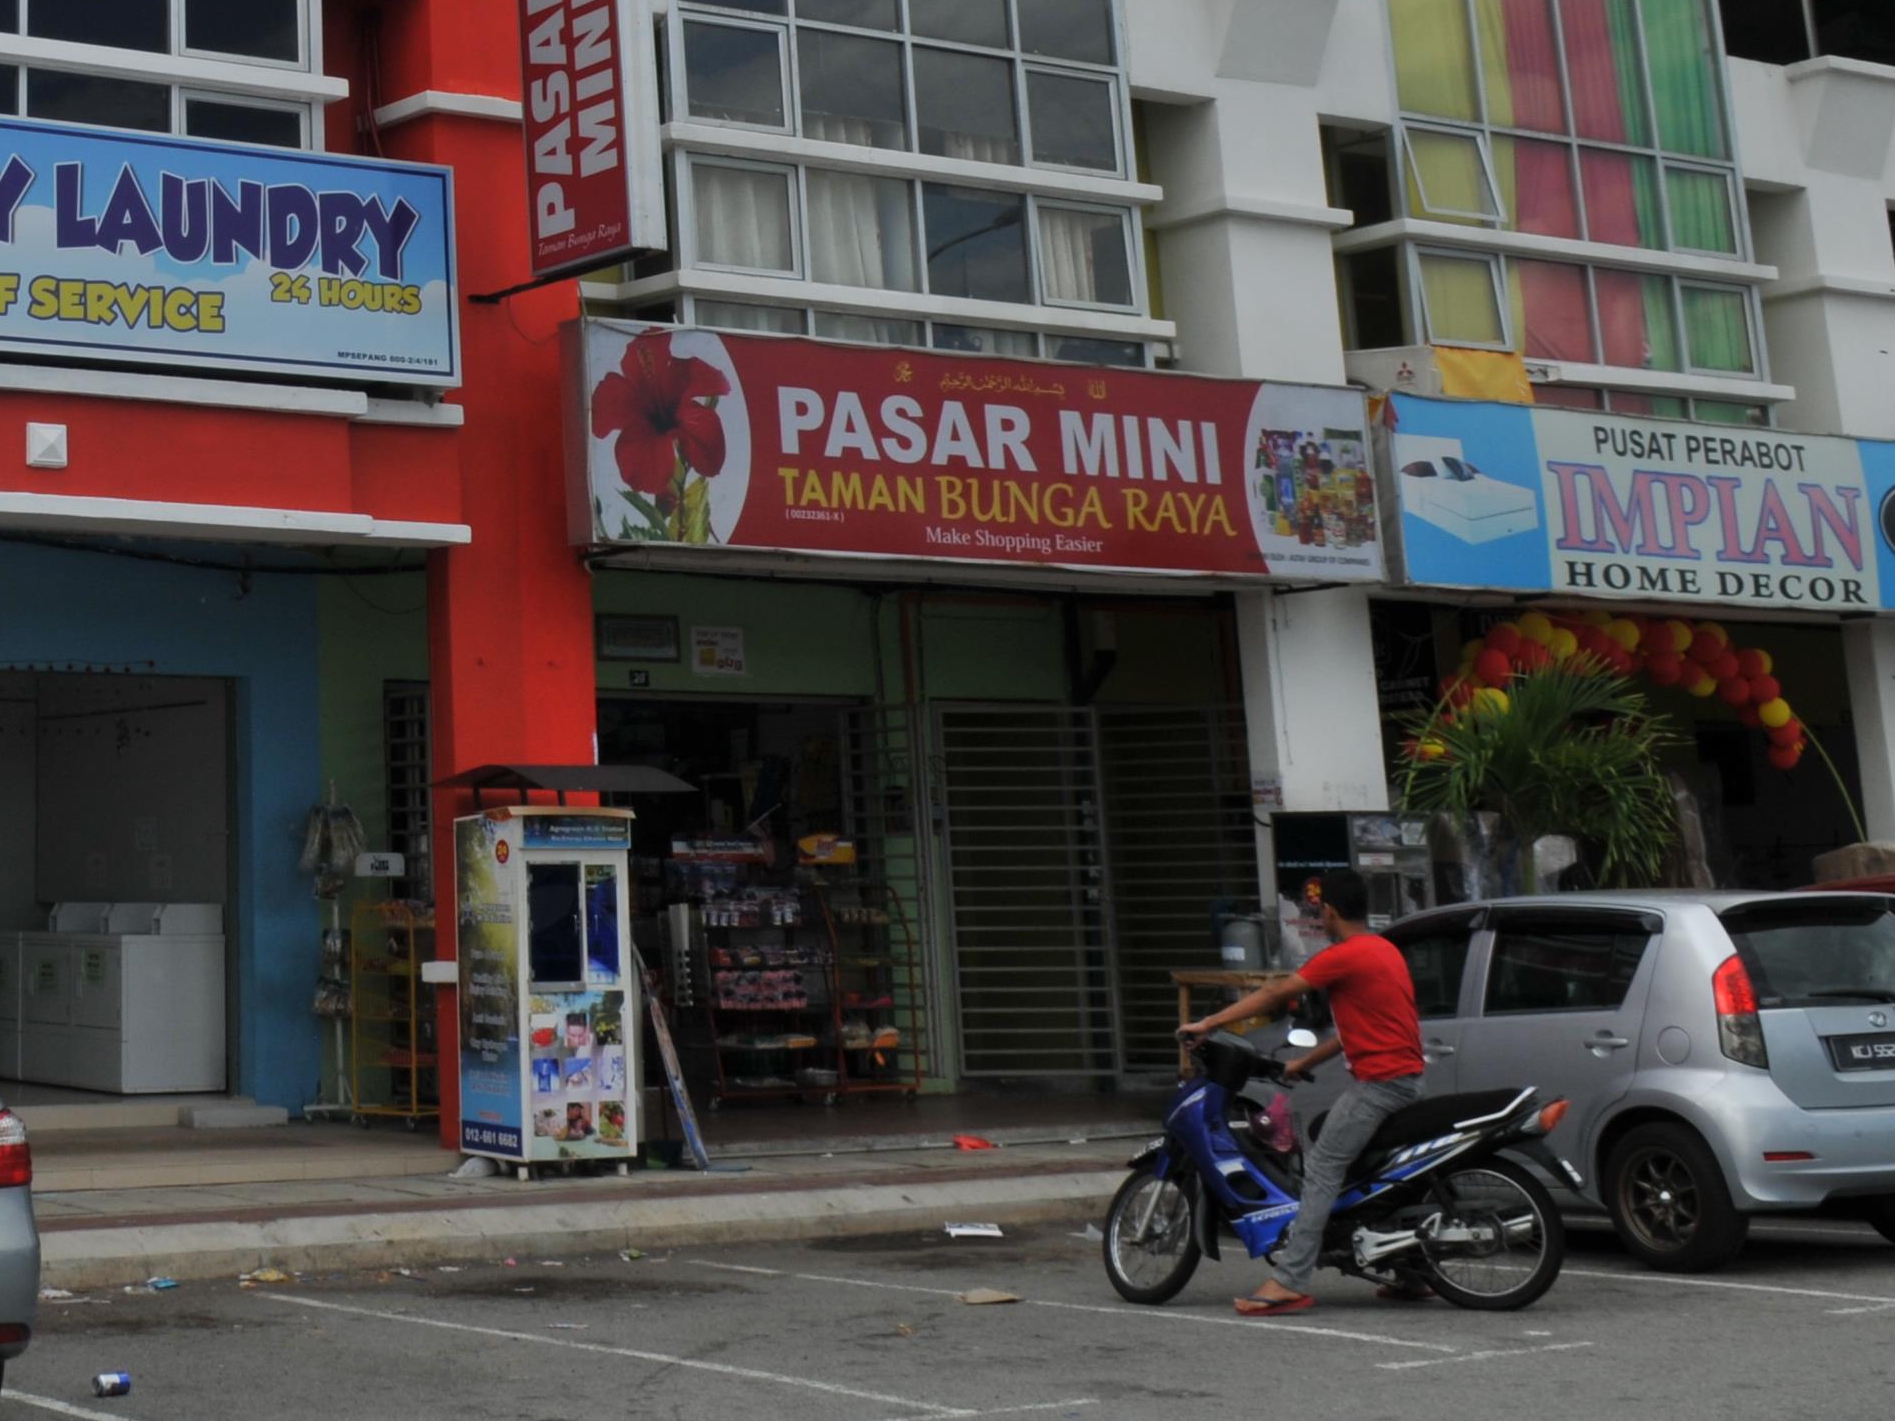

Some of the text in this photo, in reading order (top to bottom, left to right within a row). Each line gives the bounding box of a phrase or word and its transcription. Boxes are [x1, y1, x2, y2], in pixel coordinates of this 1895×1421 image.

[53, 161, 420, 282] LAUNDRY
[27, 274, 226, 334] SERVICE
[270, 272, 422, 315] 24 HOURS
[777, 385, 1223, 486] PASAR MINI
[1593, 426, 1807, 473] PUSAT PERABOT
[777, 467, 1238, 538] TAMAN BUNGA RAYA
[1546, 459, 1862, 573] IMPIAN
[926, 526, 1104, 555] Make Shopping Easier
[1564, 560, 1869, 605] HOME DECOR
